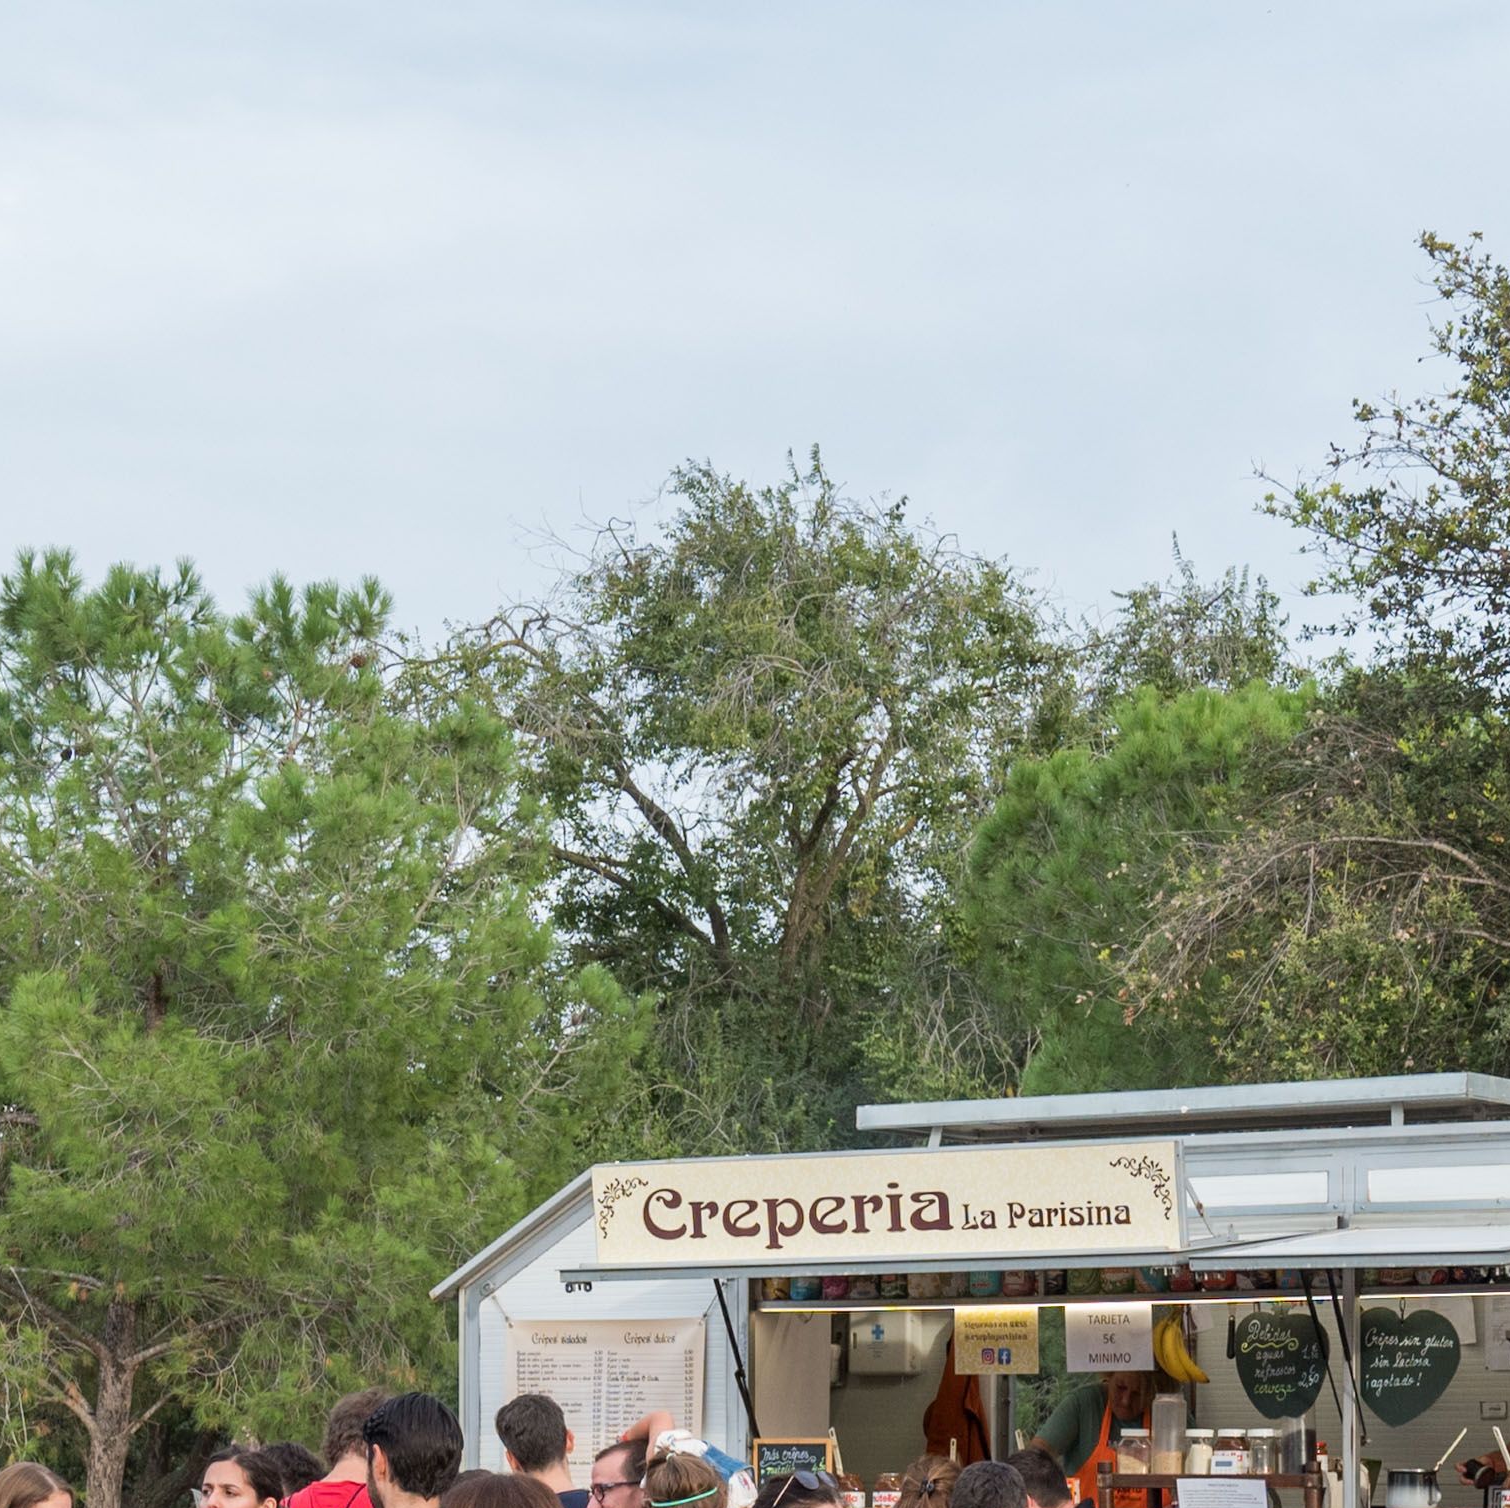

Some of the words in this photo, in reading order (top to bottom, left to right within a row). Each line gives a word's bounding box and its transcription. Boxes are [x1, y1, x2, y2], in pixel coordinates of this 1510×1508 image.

[643, 1182, 954, 1249] Creperia
[962, 1204, 997, 1231] La
[1007, 1200, 1131, 1229] Parisina
[1088, 1314, 1130, 1325] TARJETA
[1248, 1319, 1292, 1342] Bebidas
[653, 1332, 676, 1344] dulces
[1102, 1332, 1116, 1344] 5€
[1399, 1335, 1422, 1347] sin
[1420, 1335, 1454, 1356] gluten
[1088, 1352, 1132, 1364] MINIMO
[1370, 1354, 1390, 1368] sin
[1392, 1351, 1432, 1368] lactosa
